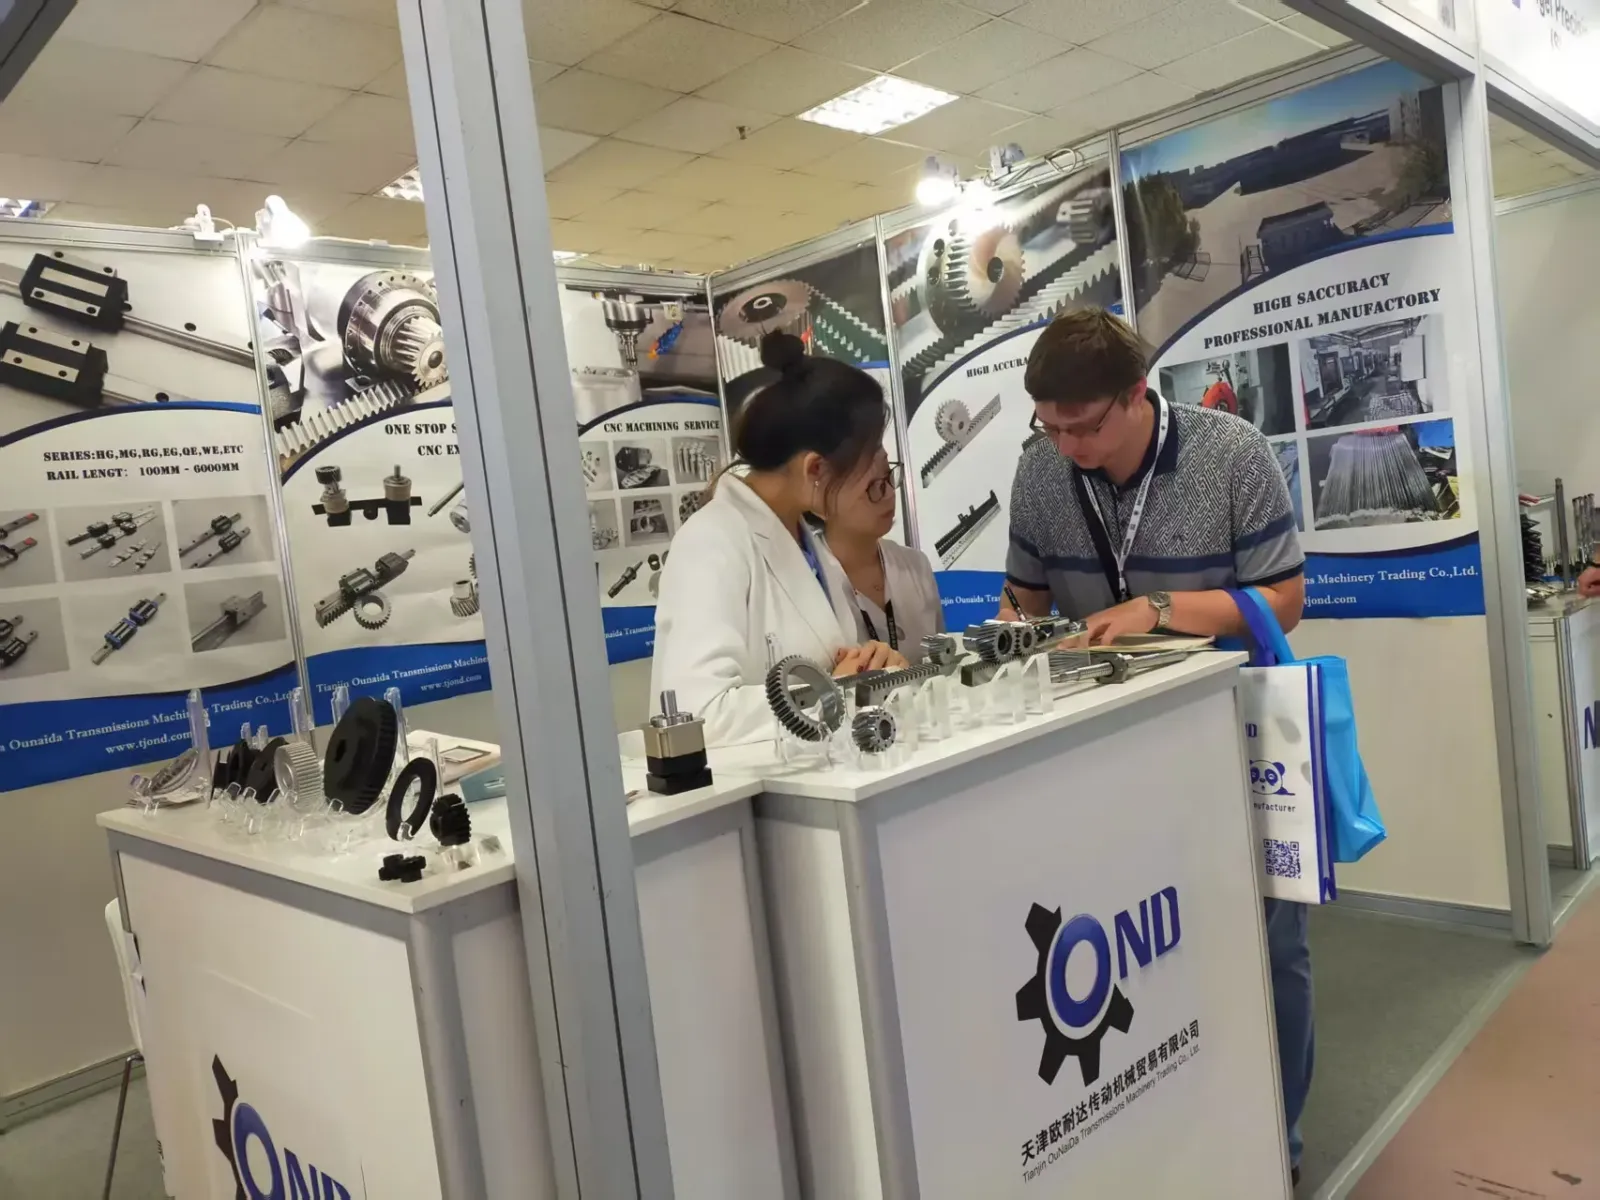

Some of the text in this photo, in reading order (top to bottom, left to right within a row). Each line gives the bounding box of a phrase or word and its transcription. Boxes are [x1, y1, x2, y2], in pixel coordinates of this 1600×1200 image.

[1253, 273, 1390, 315] HIGH SACCURACY
[1204, 288, 1441, 349] PROFESSIONAL MANUFACTORY
[966, 357, 1029, 378] HIGH ACCURA
[385, 423, 411, 435] ONE
[415, 423, 447, 435] STOP
[604, 420, 721, 433] CNC MACHINING SERVICE
[417, 444, 461, 456] CNC EX
[47, 470, 79, 481] RAIL
[139, 465, 180, 477] 100MM
[193, 462, 240, 474] 6000MM
[1317, 573, 1375, 586] Machinery
[1378, 569, 1426, 582] Trading
[1429, 566, 1479, 579] Co.,Ltd.
[1303, 595, 1357, 607] tjond.com
[352, 672, 390, 686] Ounaida
[392, 662, 452, 679] Transmissions
[453, 656, 488, 668] Machine
[9, 733, 63, 751] Ounaida
[65, 718, 150, 741] Transmissions
[211, 698, 253, 713] Trading
[105, 731, 194, 755] www.tjond.com
[1049, 886, 1182, 1028] OND
[1021, 1019, 1200, 1167] 天津欧耐达传动机械贸易有限公司
[1022, 1160, 1047, 1184] Tianjin
[1047, 1134, 1080, 1165] OuNaiDa
[1080, 1101, 1125, 1141] Transmissions
[1125, 1078, 1156, 1104] Machinery
[1156, 1061, 1178, 1081] Trading
